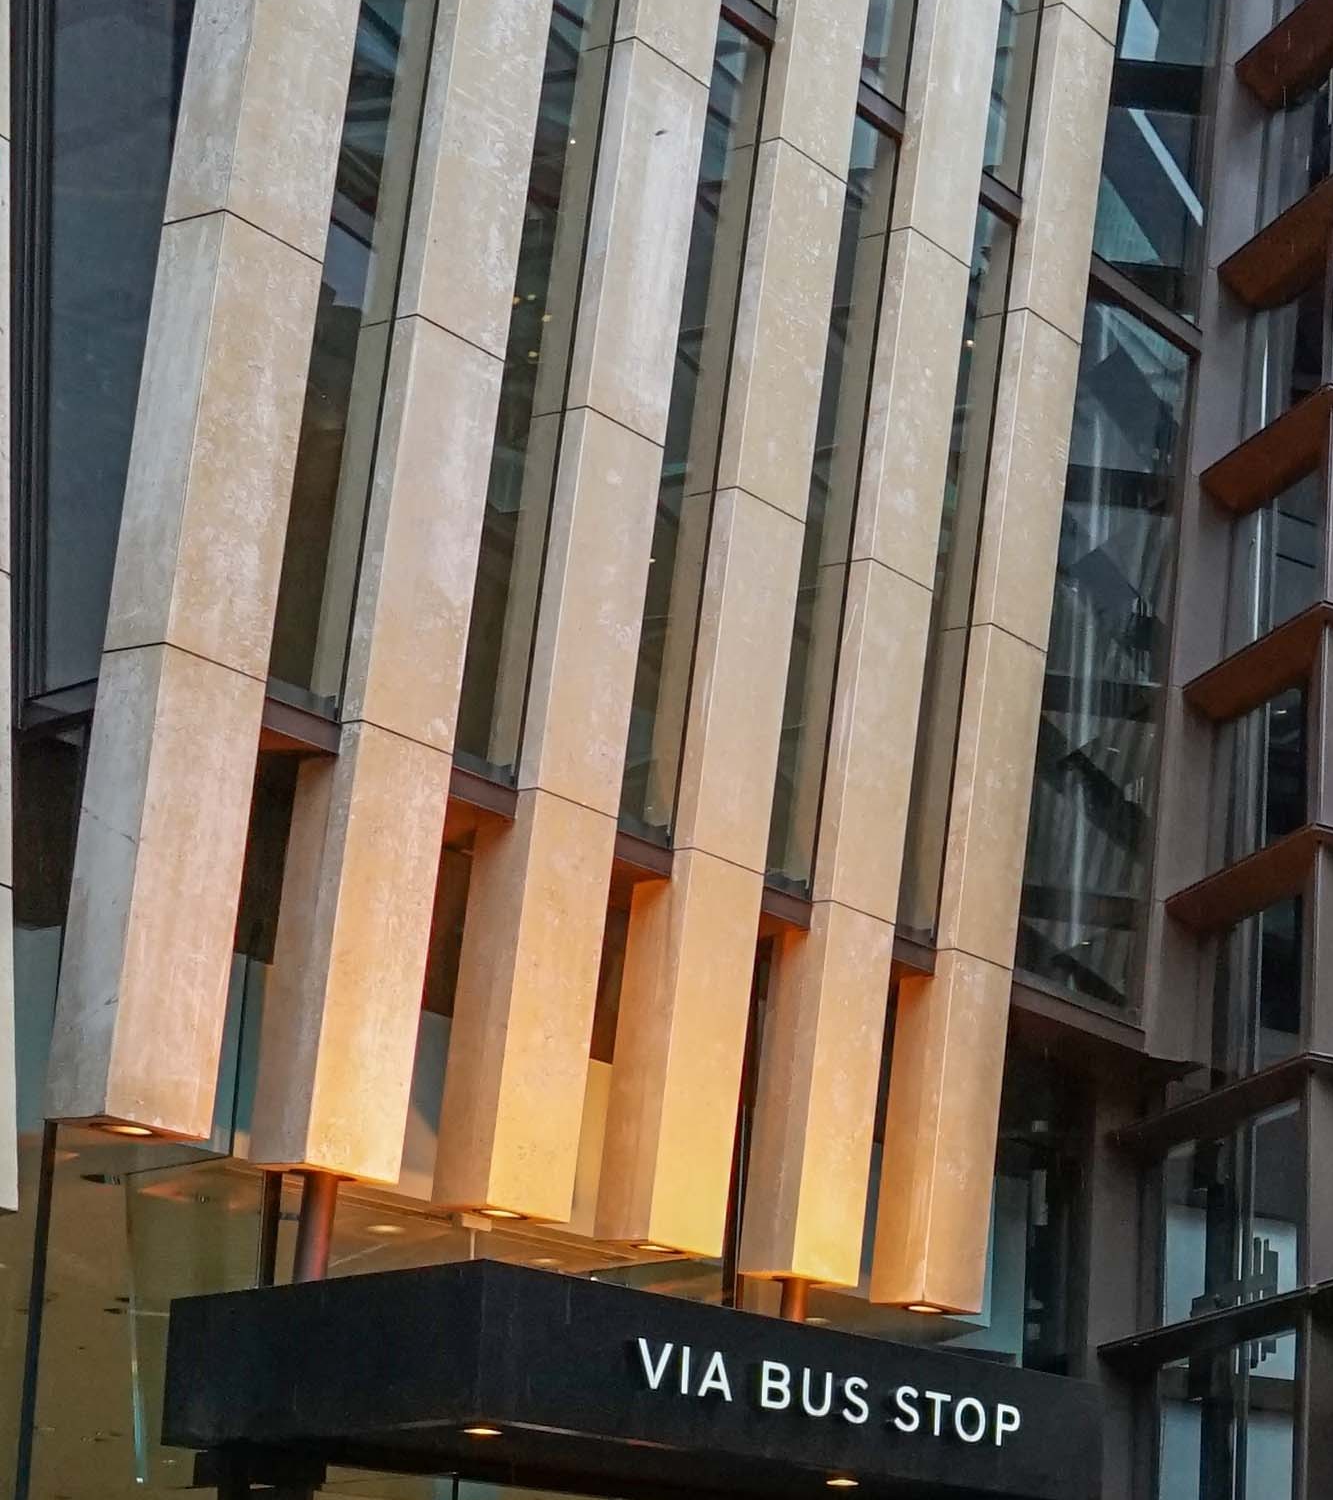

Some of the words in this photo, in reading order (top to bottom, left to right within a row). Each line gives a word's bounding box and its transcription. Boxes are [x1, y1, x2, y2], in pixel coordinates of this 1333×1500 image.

[638, 1337, 733, 1402] VIA
[761, 1360, 869, 1425] BUS
[893, 1385, 1021, 1447] STOP
